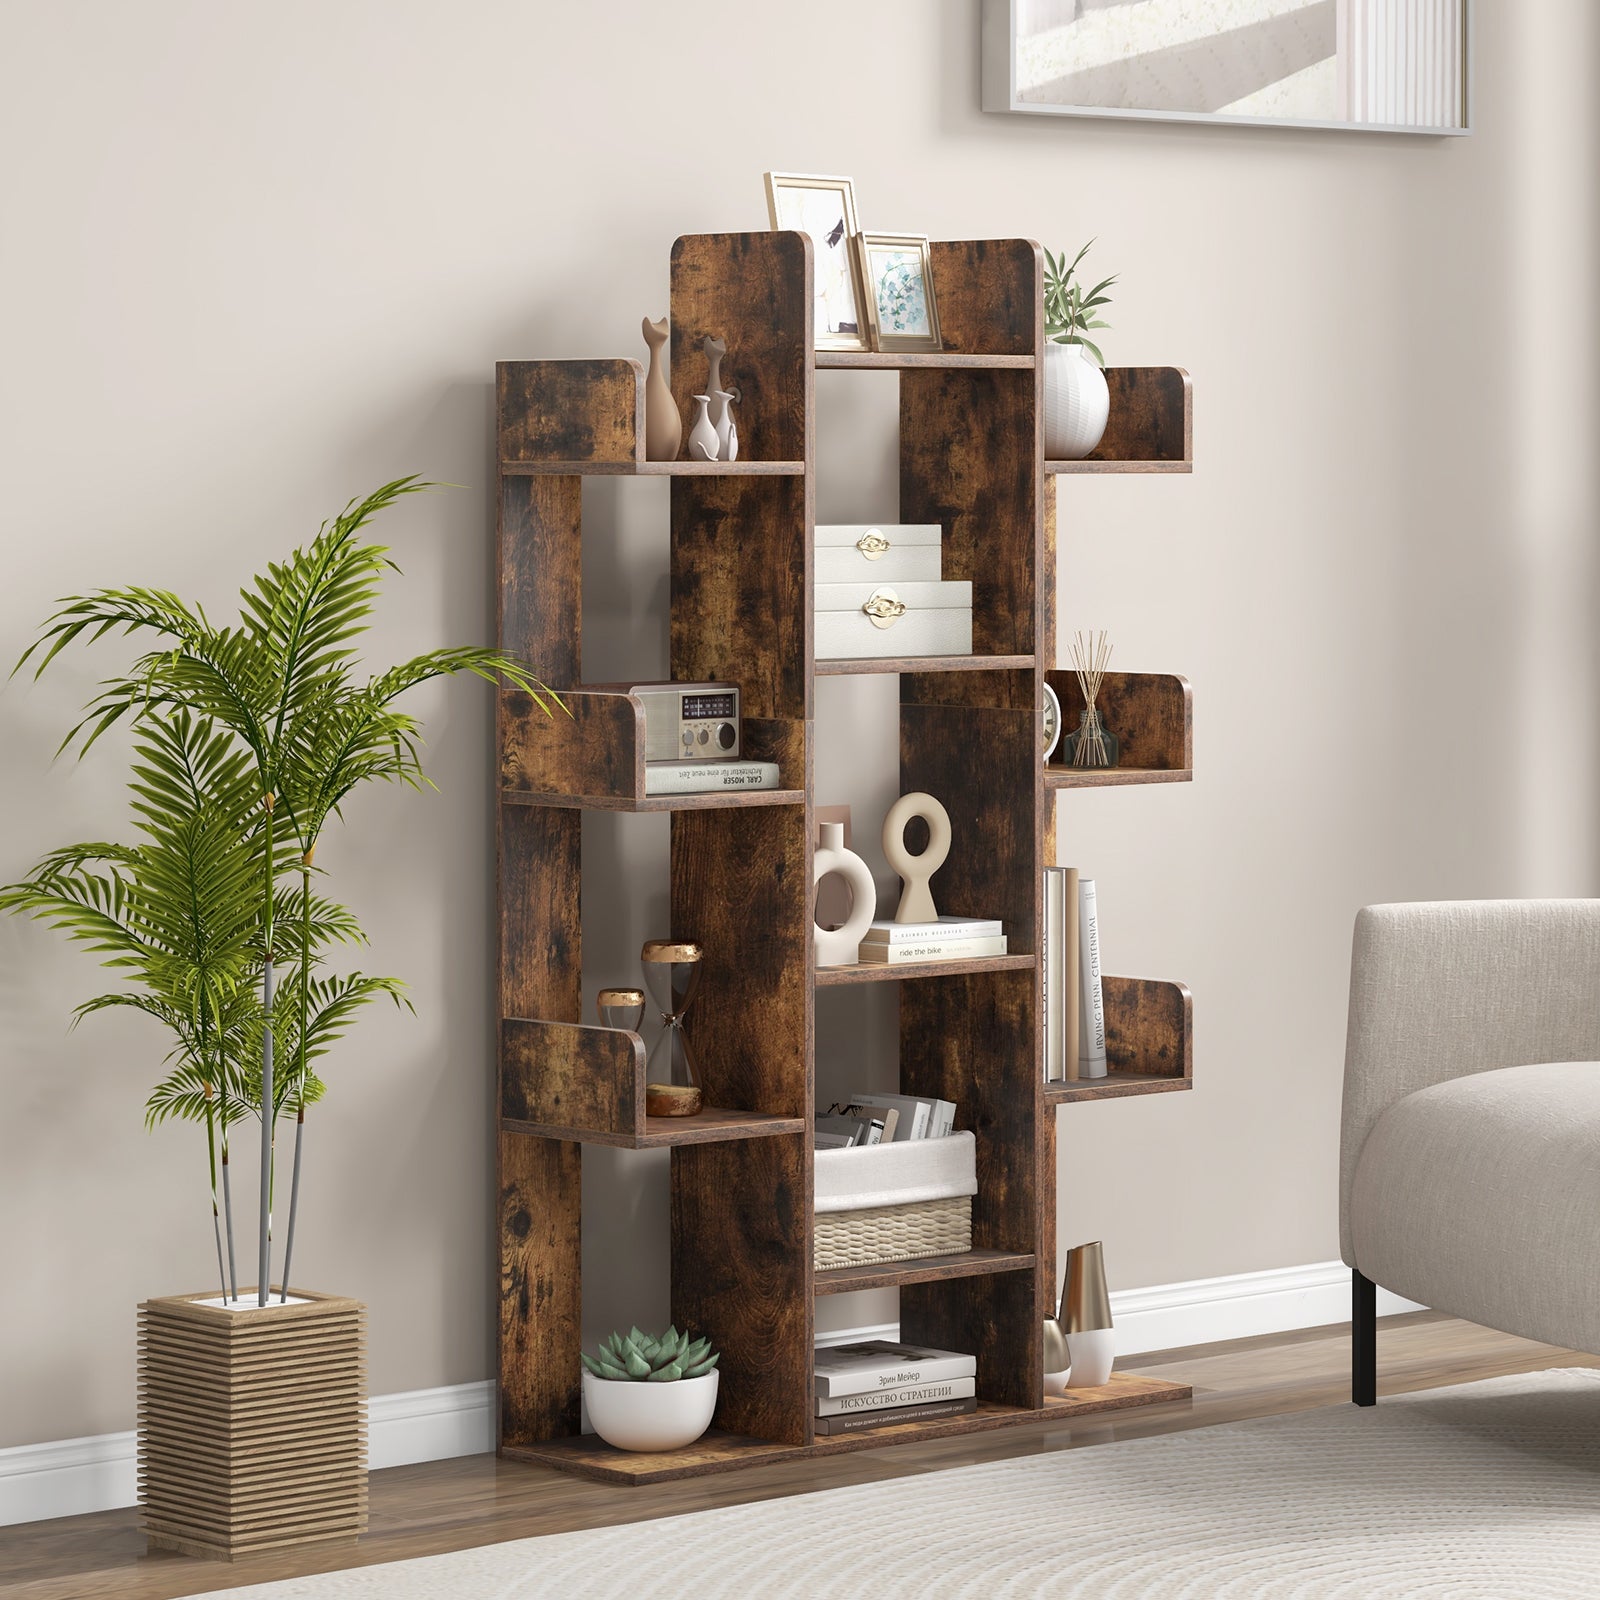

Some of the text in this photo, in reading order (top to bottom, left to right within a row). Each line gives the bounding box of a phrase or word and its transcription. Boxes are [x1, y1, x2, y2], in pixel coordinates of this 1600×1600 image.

[900, 948, 913, 956] ride
[914, 947, 926, 956] the
[927, 946, 942, 954] bike
[1088, 916, 1100, 978] CENTENNIAL
[1094, 1012, 1104, 1050] IRVING
[879, 1372, 920, 1386] Эрин Мейер
[841, 1386, 952, 1409] ИСКУССТВО СТРАТЕГИИ
